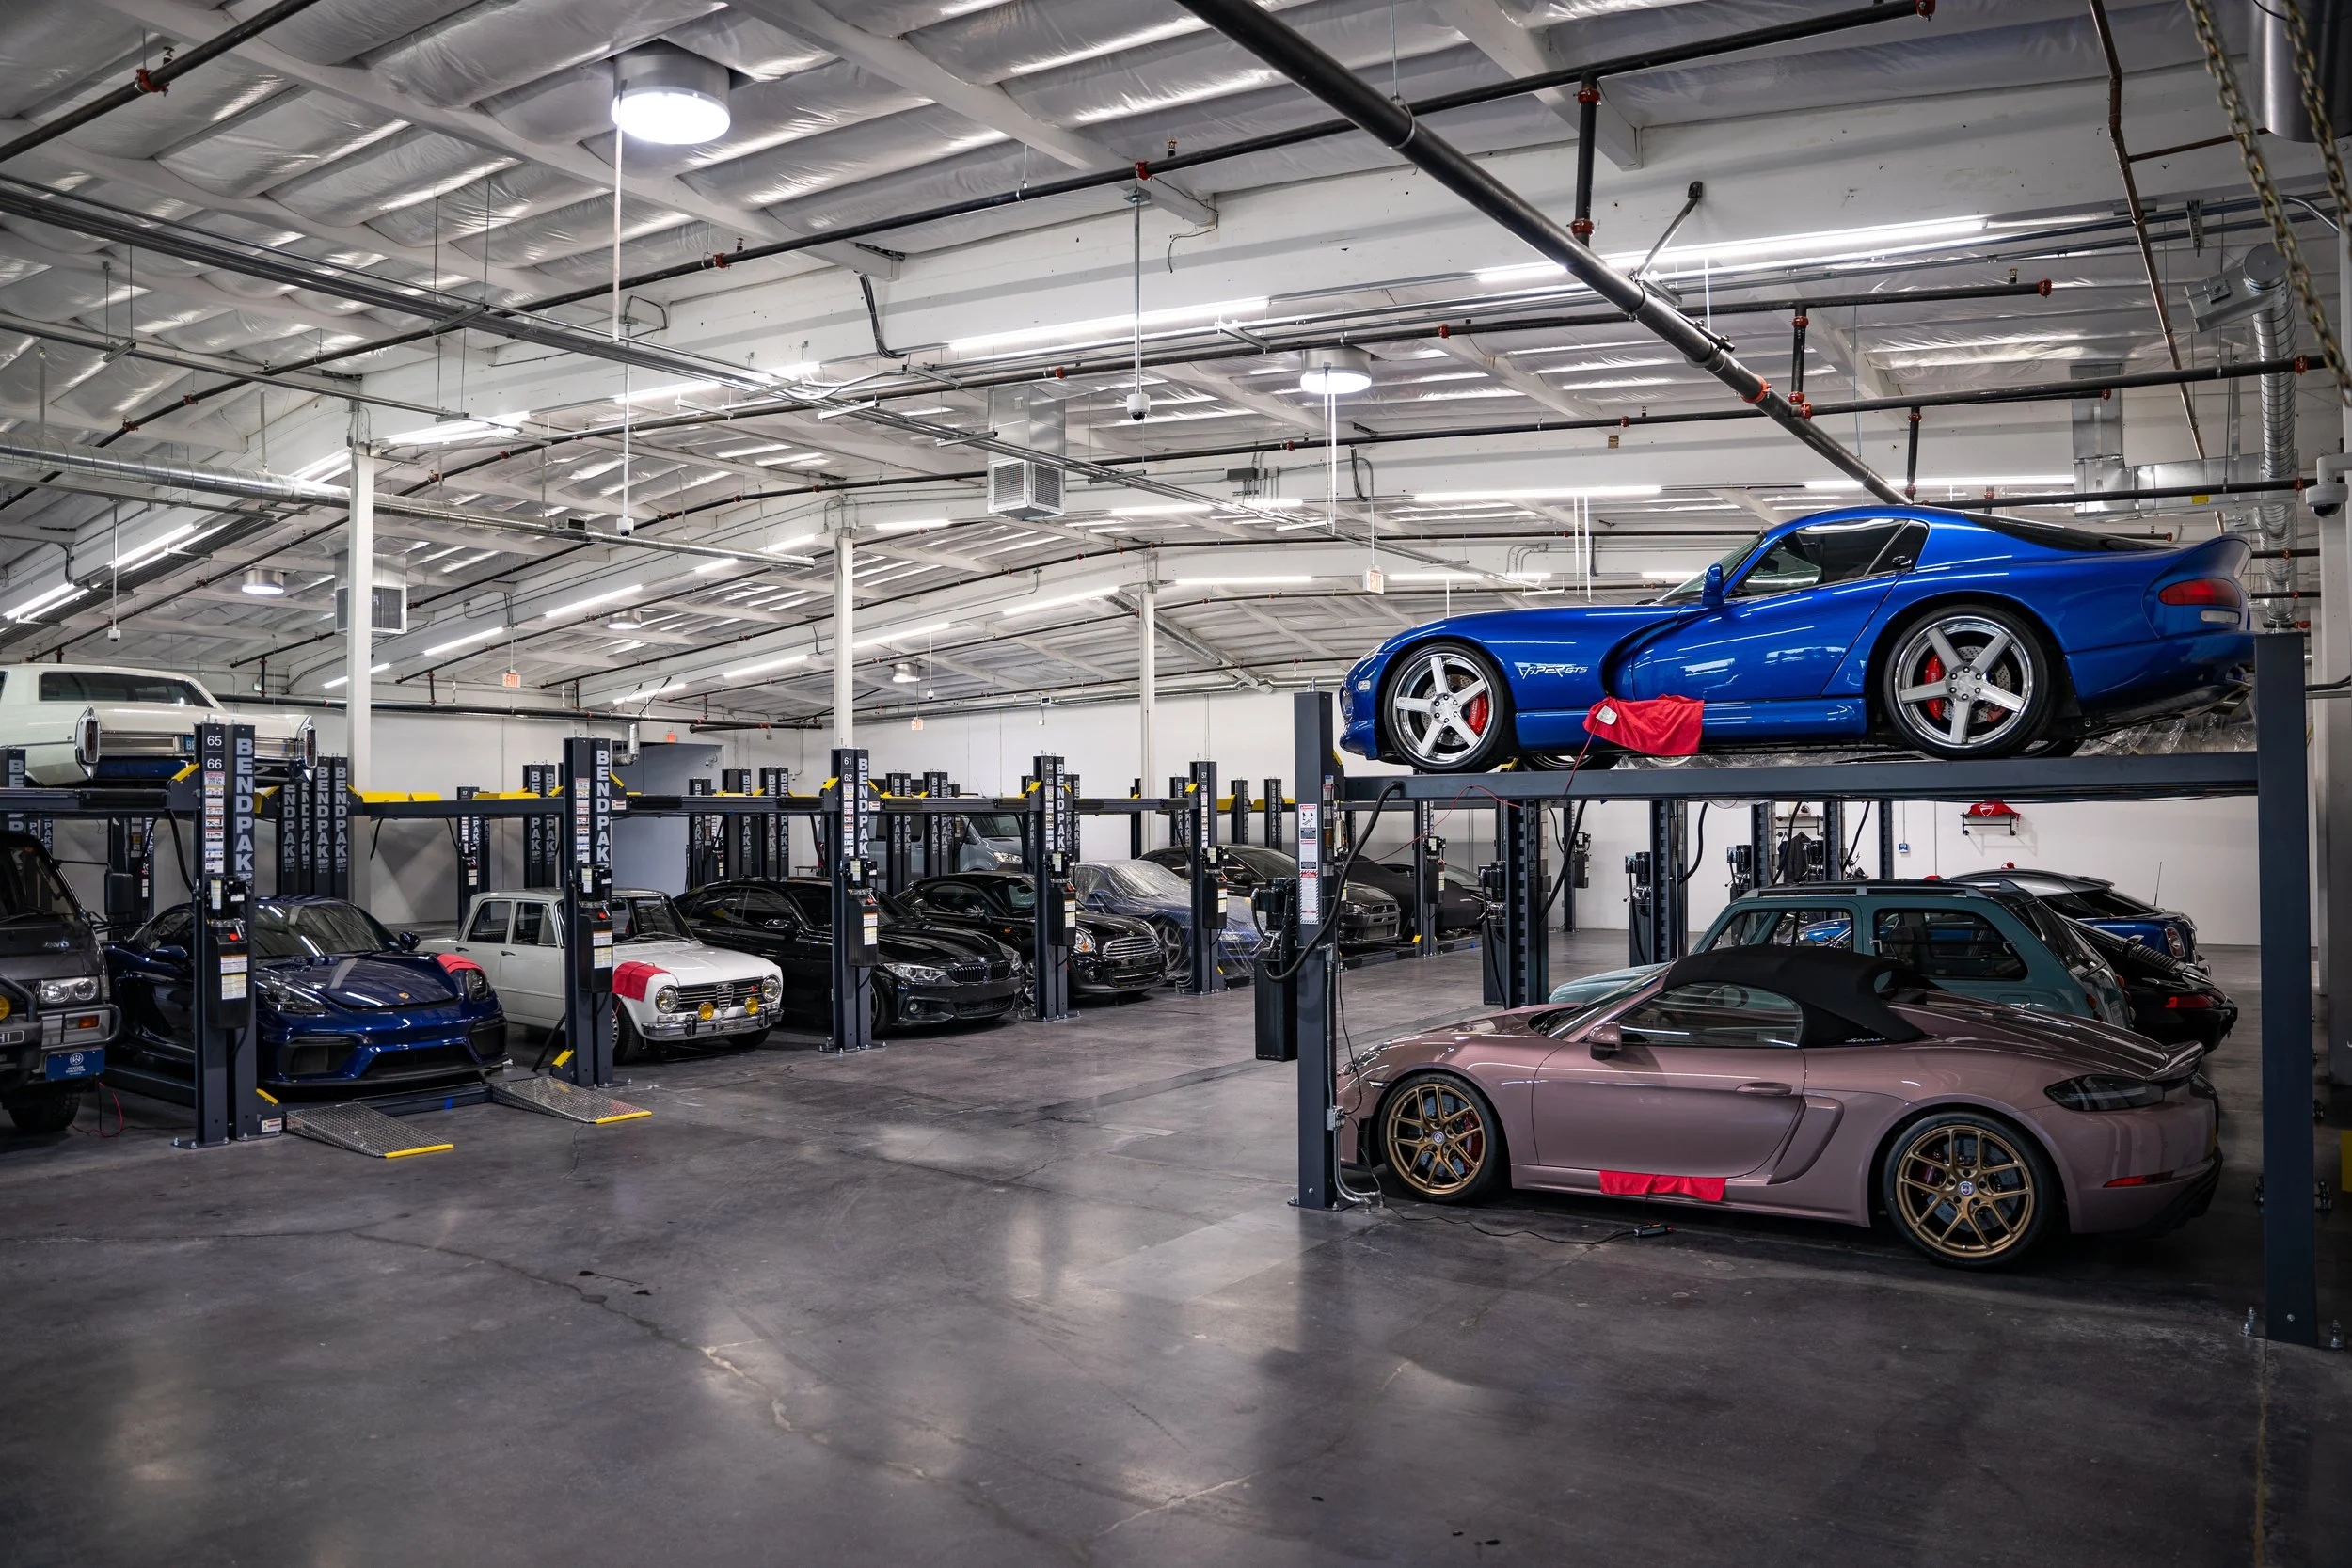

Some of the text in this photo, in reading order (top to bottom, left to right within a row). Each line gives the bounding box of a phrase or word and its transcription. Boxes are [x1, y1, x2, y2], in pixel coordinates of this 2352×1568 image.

[206, 735, 223, 747] 65
[206, 758, 223, 769] 66
[843, 773, 852, 782] 62
[844, 756, 852, 765] 61
[236, 738, 254, 871] BENDPAK
[284, 784, 295, 857] ENDPAK
[317, 766, 329, 858] BENDPAK
[335, 766, 347, 857] BENDPAK
[596, 750, 610, 862] BENDPAK
[858, 758, 869, 854] BENDPAK
[1057, 763, 1065, 847] BENDPAK
